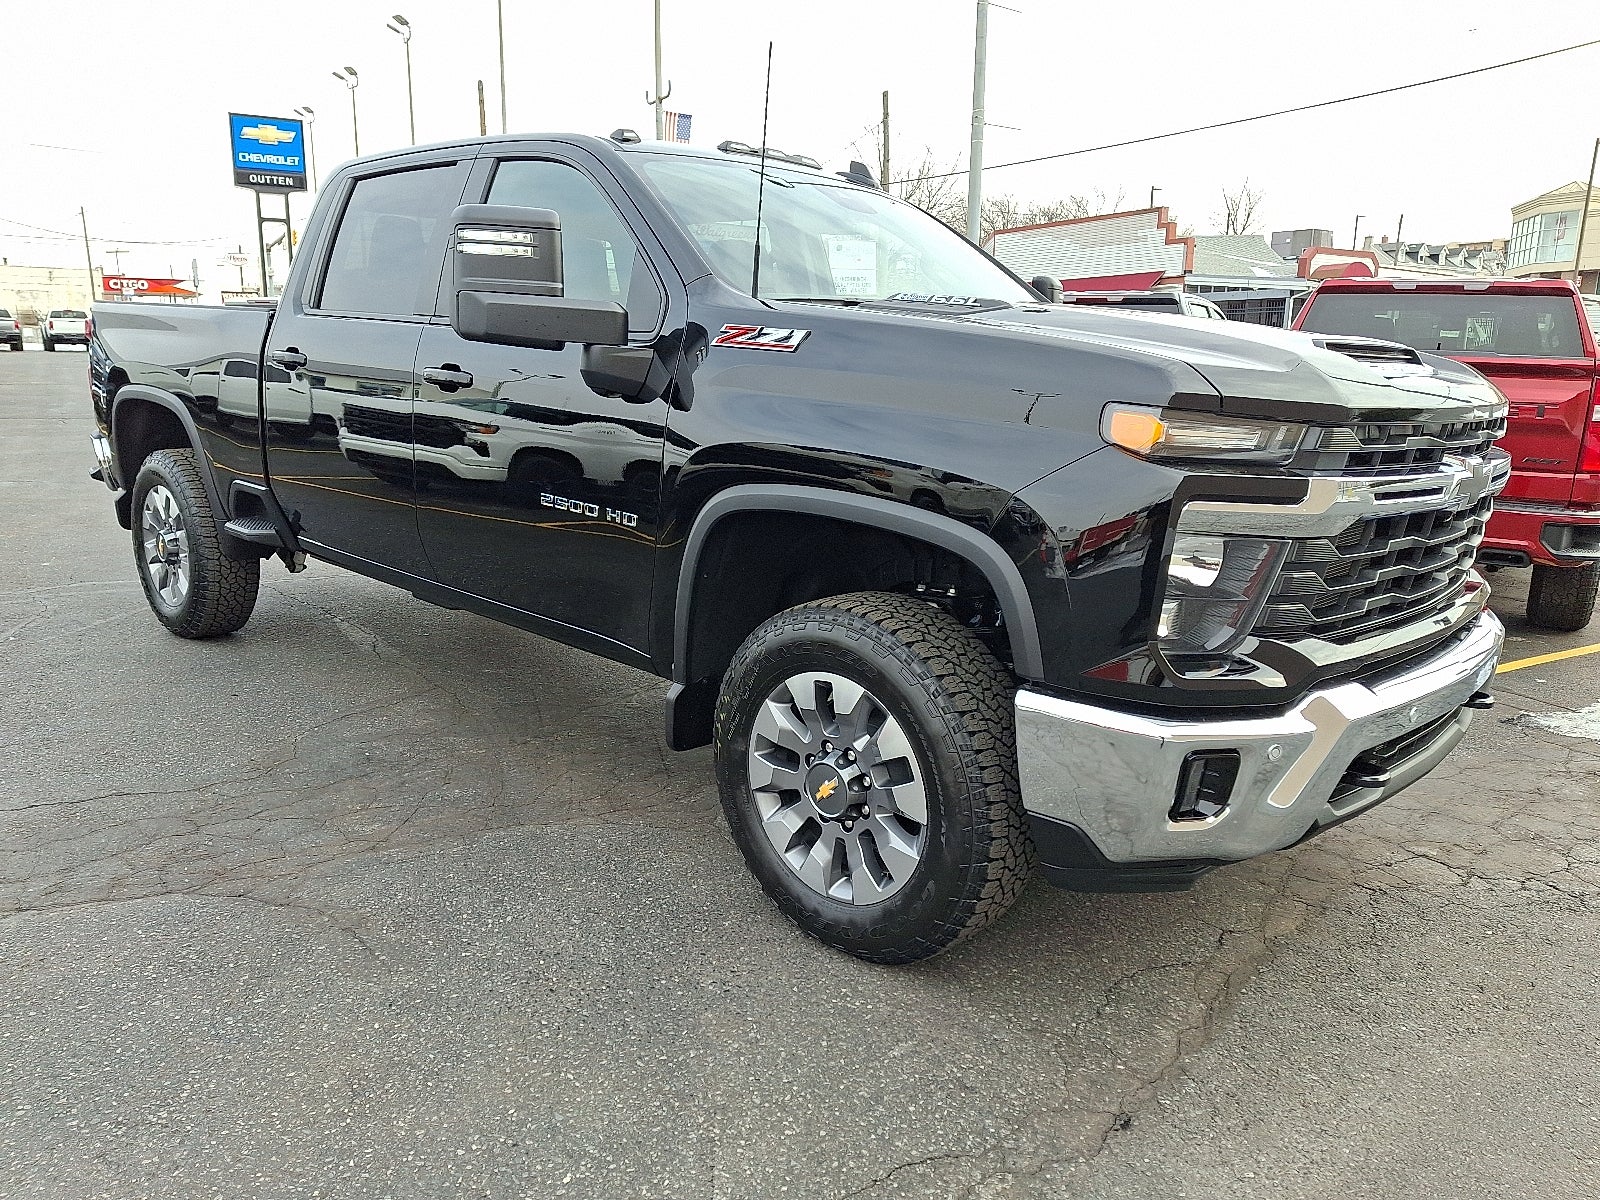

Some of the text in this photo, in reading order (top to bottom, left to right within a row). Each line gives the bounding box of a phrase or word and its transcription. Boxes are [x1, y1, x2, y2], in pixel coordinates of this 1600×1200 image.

[238, 152, 300, 166] CHEVROLET
[249, 174, 294, 186] OUTTEN
[108, 278, 149, 290] CITGO
[710, 323, 812, 353] Z71
[541, 493, 638, 527] 2500 HD
